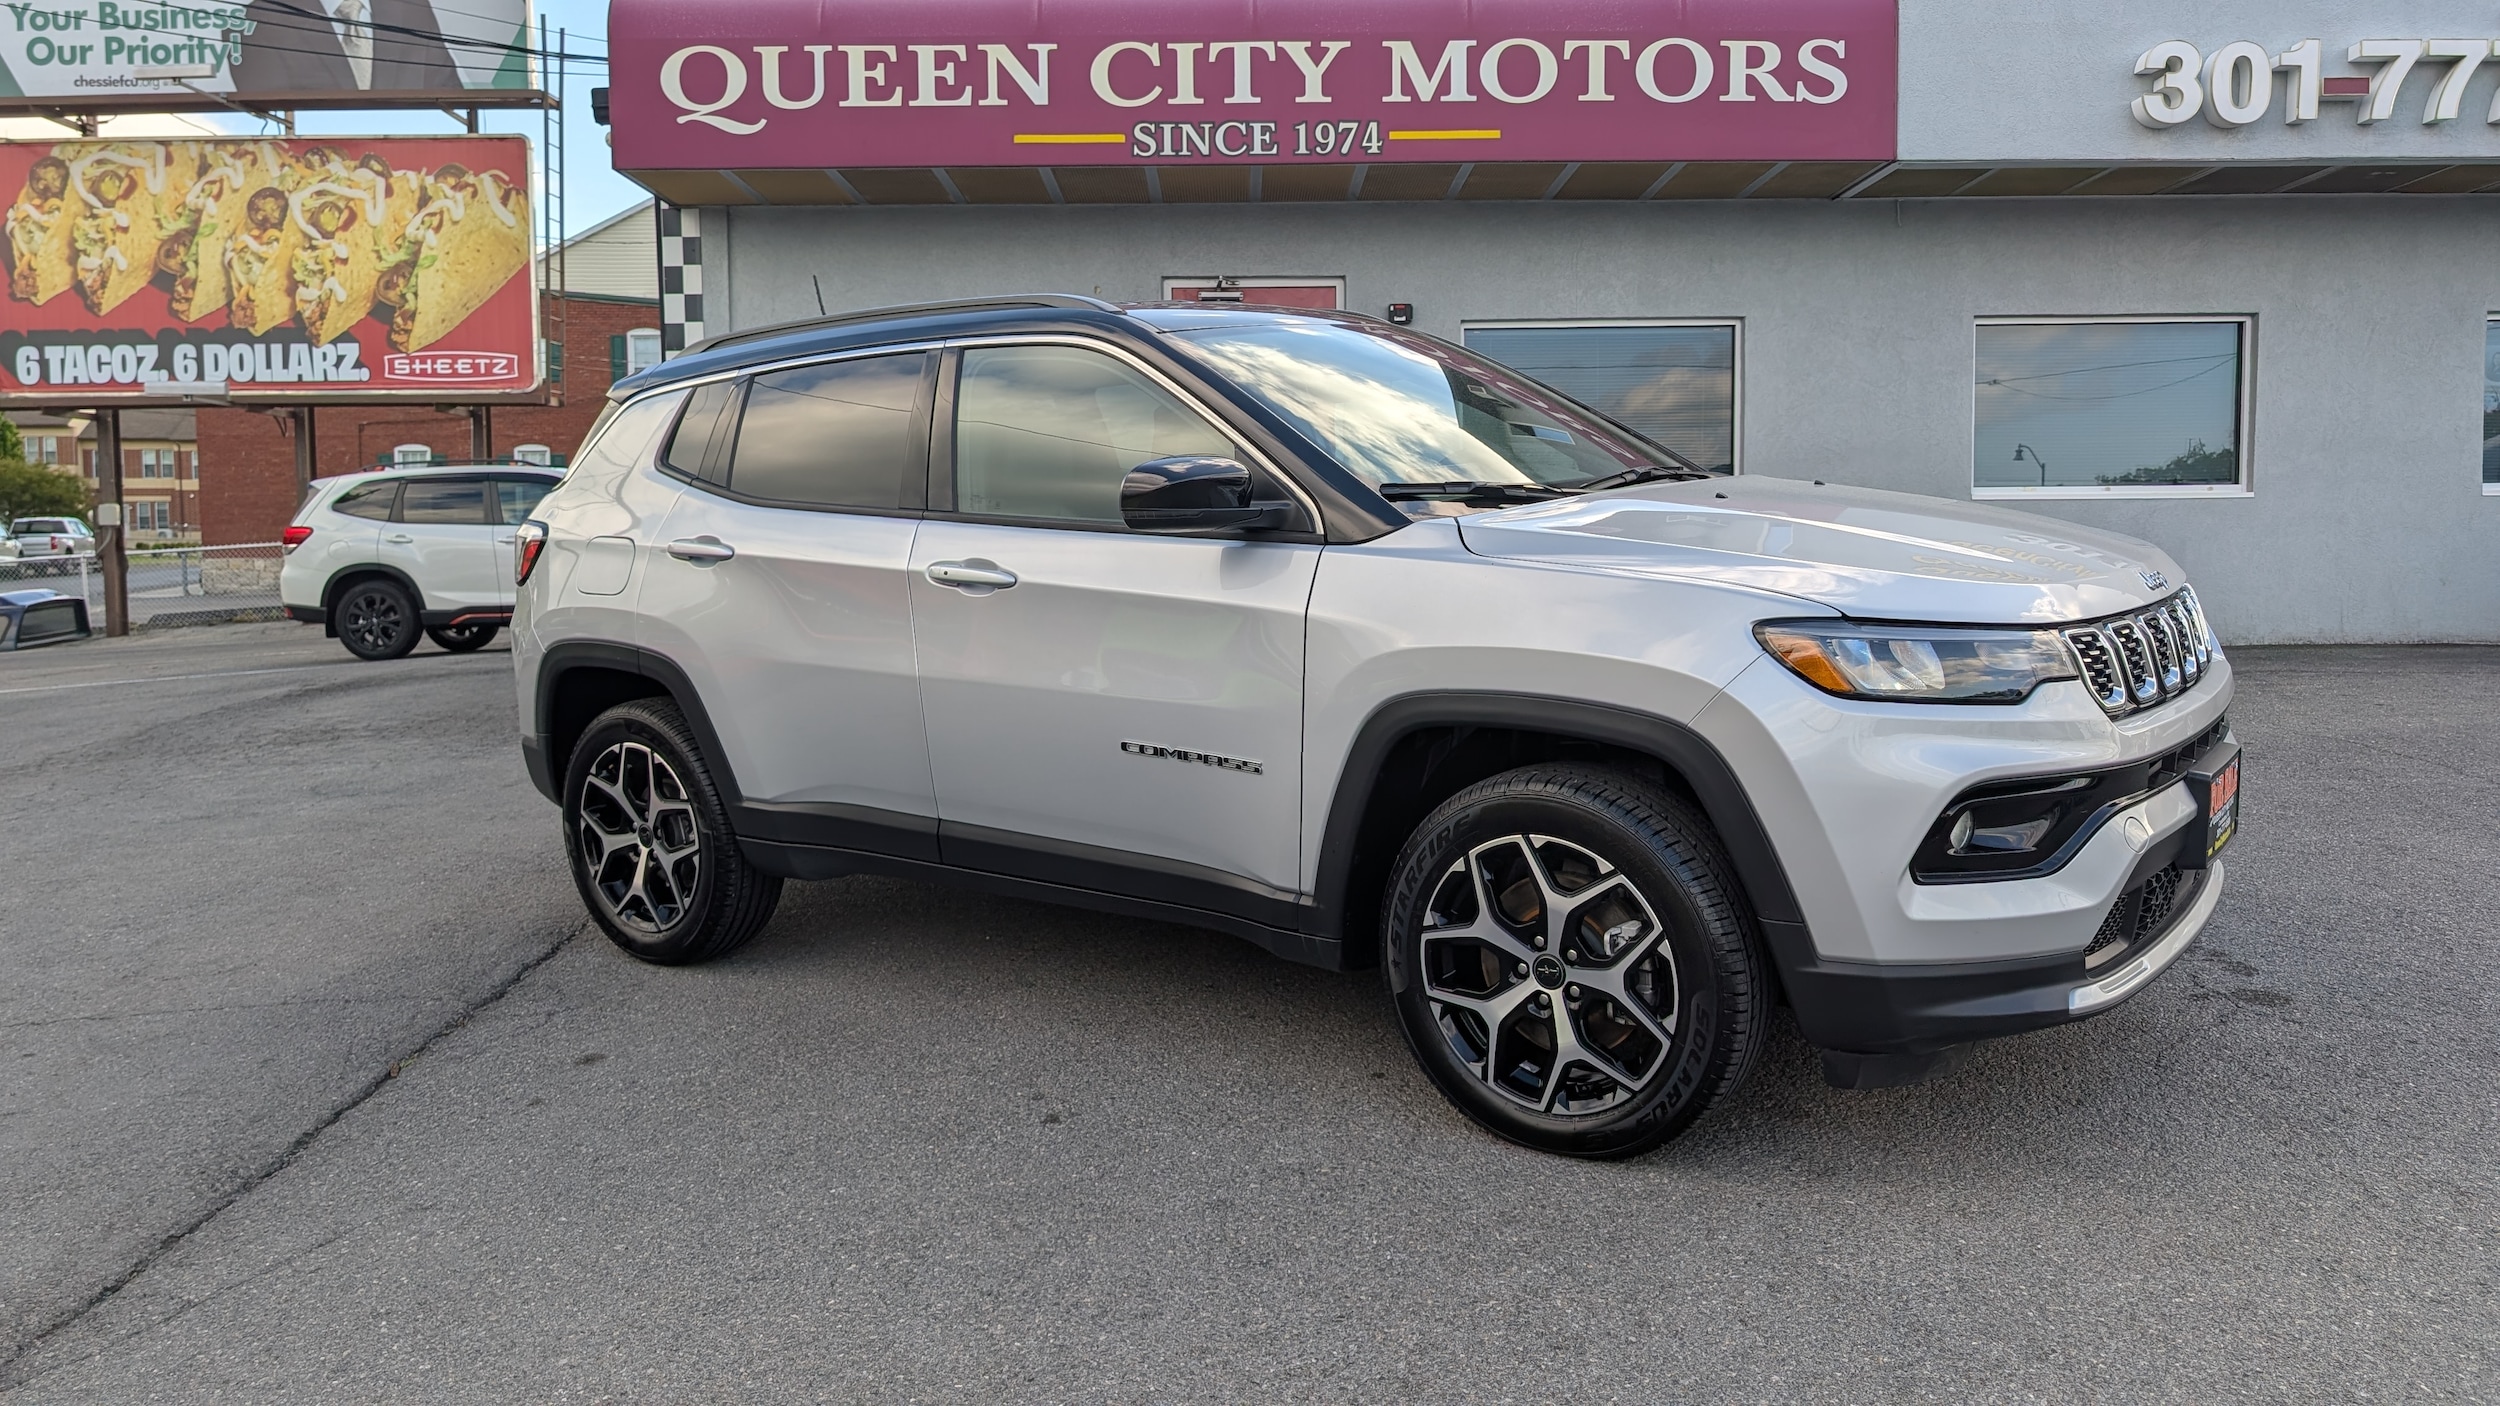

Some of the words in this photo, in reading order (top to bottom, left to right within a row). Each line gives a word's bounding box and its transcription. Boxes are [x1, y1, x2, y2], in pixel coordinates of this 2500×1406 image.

[8, 1, 88, 32] Your
[98, 0, 257, 35] Business,
[25, 36, 94, 66] Our
[104, 33, 243, 73] Priority!
[659, 43, 1058, 136] QUEEN
[1088, 40, 1352, 108] CITY
[1380, 37, 1849, 105] MOTORS
[1132, 121, 1279, 158] SINCE
[1291, 119, 1384, 156] 1974
[15, 344, 41, 385] 6
[44, 343, 170, 385] TACOZ.
[173, 343, 198, 383] 6
[202, 342, 371, 383] DOLLARZ.
[393, 358, 509, 375] SHEETZ
[1120, 740, 1264, 775] COMPASS
[1390, 812, 1471, 950] STARFIRE
[1635, 1001, 1710, 1128] SOLARUS
